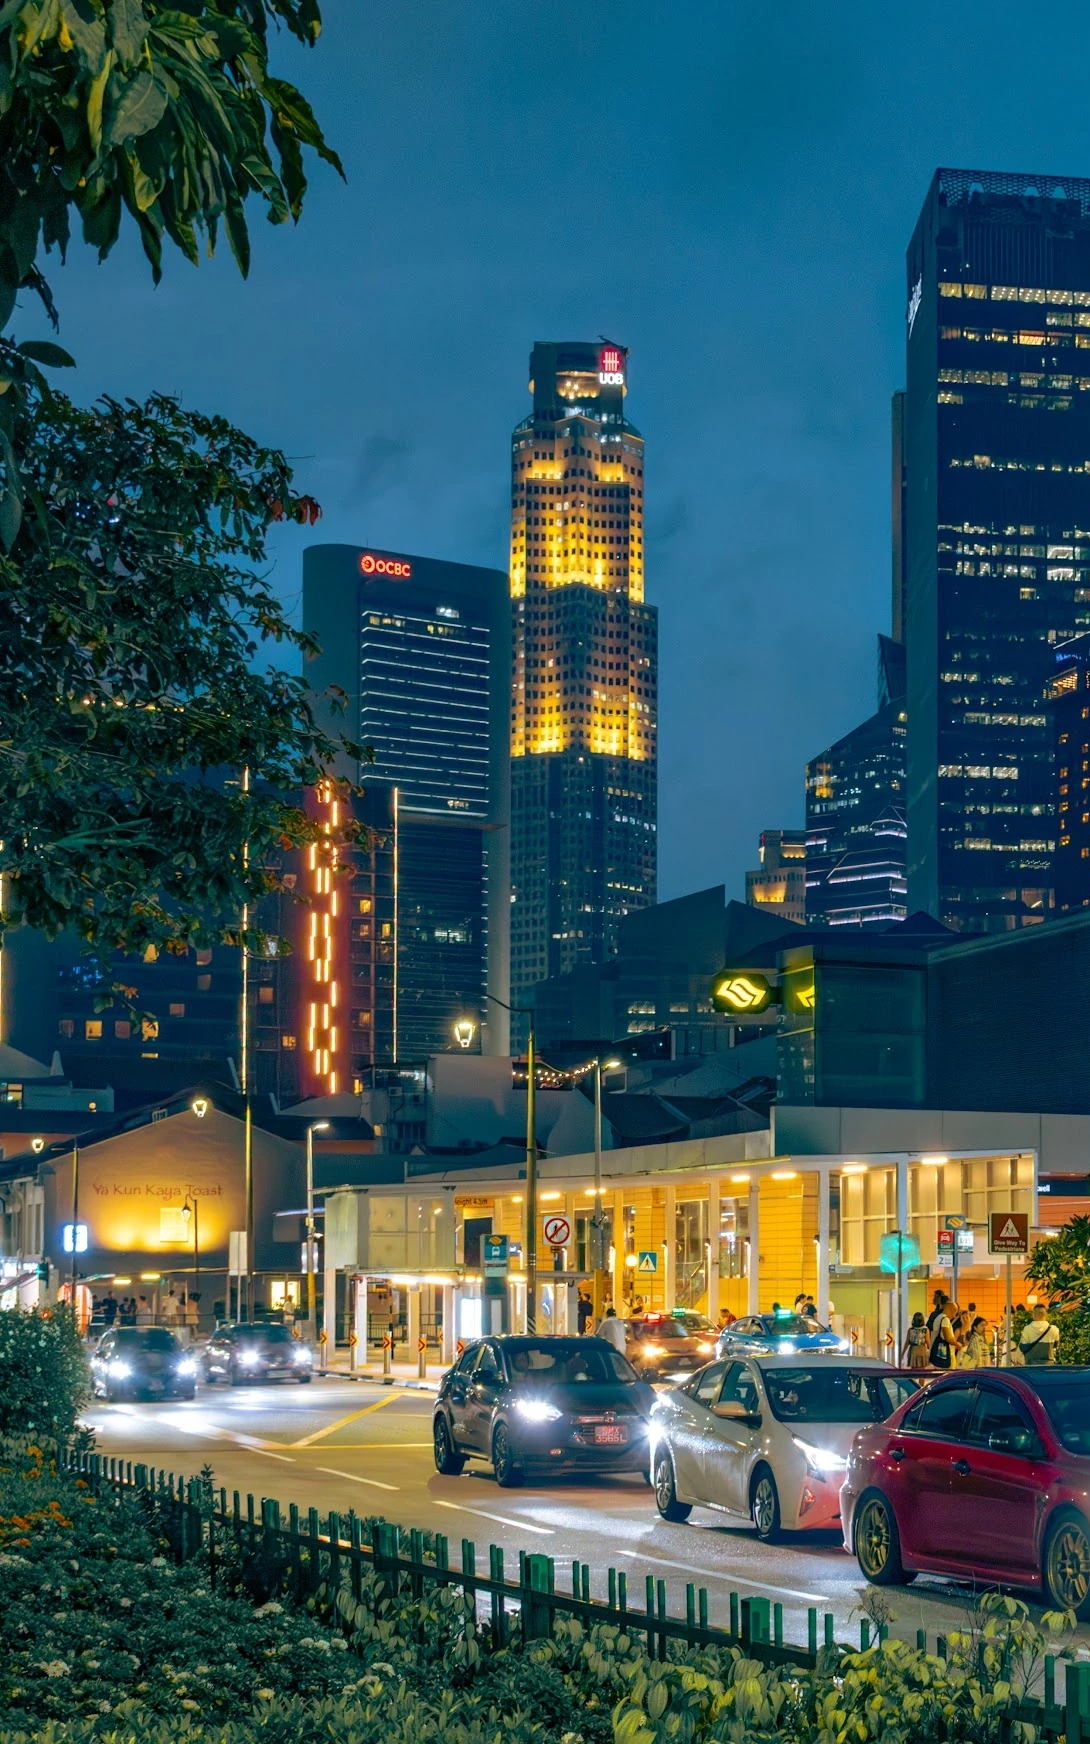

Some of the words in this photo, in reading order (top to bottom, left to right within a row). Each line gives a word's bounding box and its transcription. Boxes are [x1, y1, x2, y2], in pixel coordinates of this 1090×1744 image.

[599, 372, 624, 385] UOB
[375, 559, 411, 577] OCBC
[93, 1183, 109, 1196] Ya
[113, 1183, 142, 1196] Kun
[145, 1184, 182, 1201] Kaya
[184, 1184, 225, 1197] Toast
[938, 1256, 944, 1265] 2
